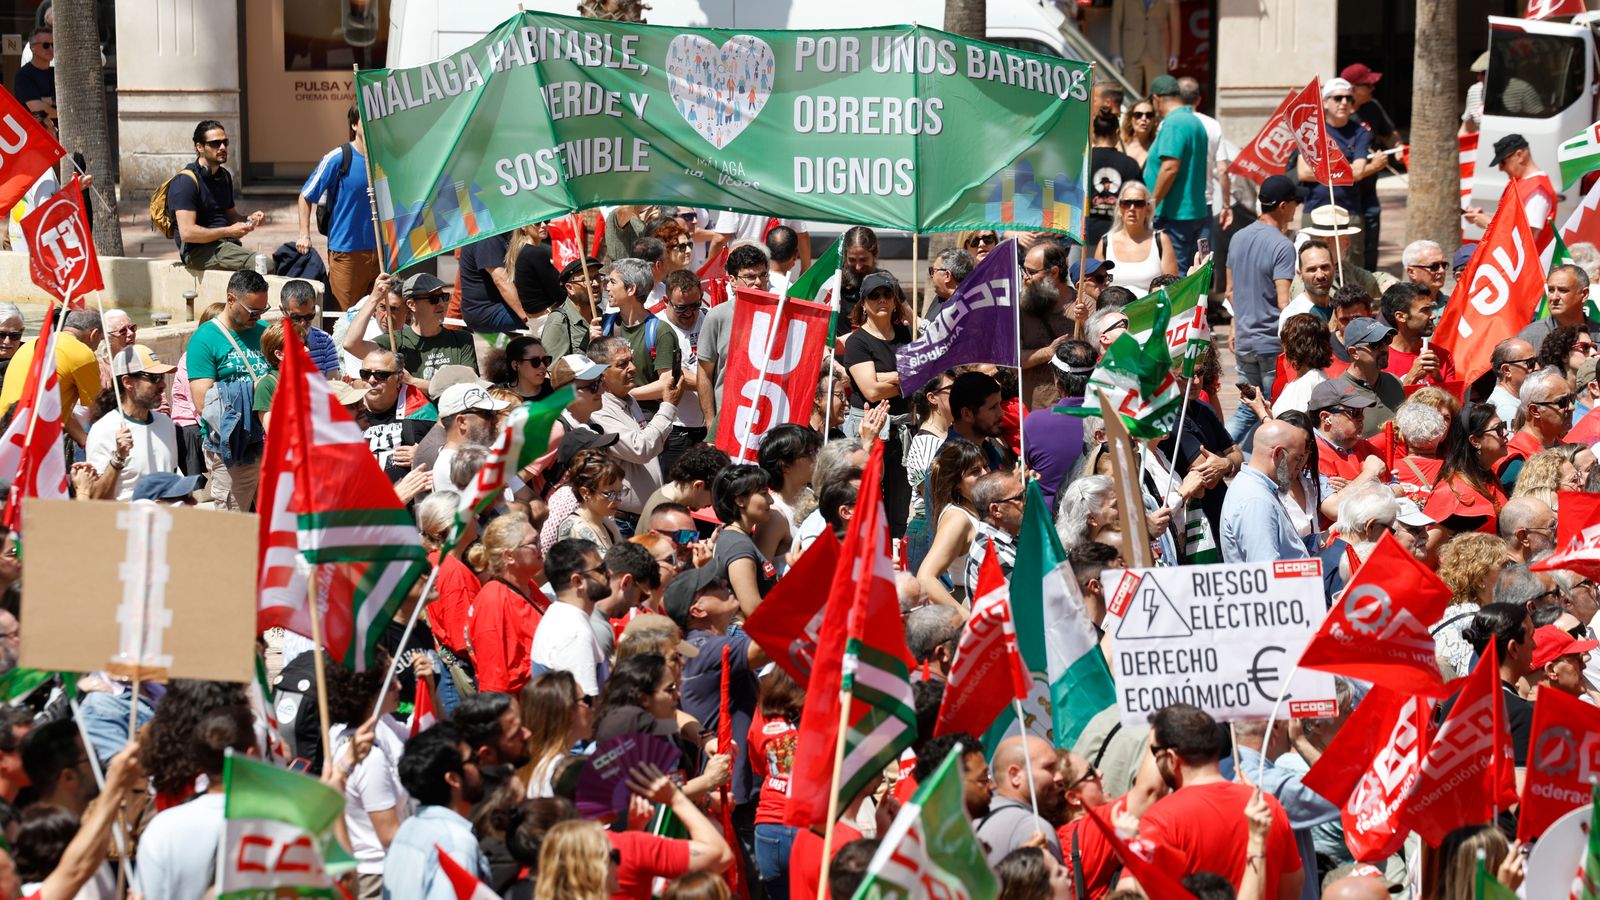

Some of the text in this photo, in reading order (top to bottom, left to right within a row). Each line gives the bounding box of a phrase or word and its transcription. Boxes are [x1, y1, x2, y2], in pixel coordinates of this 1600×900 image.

[362, 26, 650, 122] MÁLAGA HABITABLE,
[795, 36, 1089, 103] POR UNOS BARRIOS
[295, 81, 352, 92] PULSA Y
[295, 93, 329, 101] CREMA
[631, 93, 649, 121] Y
[793, 94, 945, 136] OBREROS
[793, 156, 915, 197] DIGNOS
[1192, 569, 1268, 597] RIESGO
[1275, 562, 1309, 574] CCOO
[1110, 582, 1129, 614] CCOO
[1190, 596, 1310, 630] ELÉCTRICO,
[1121, 648, 1218, 676] DERECHO
[1125, 679, 1250, 713] ECONÓMICO
[1291, 702, 1326, 713] CCOO
